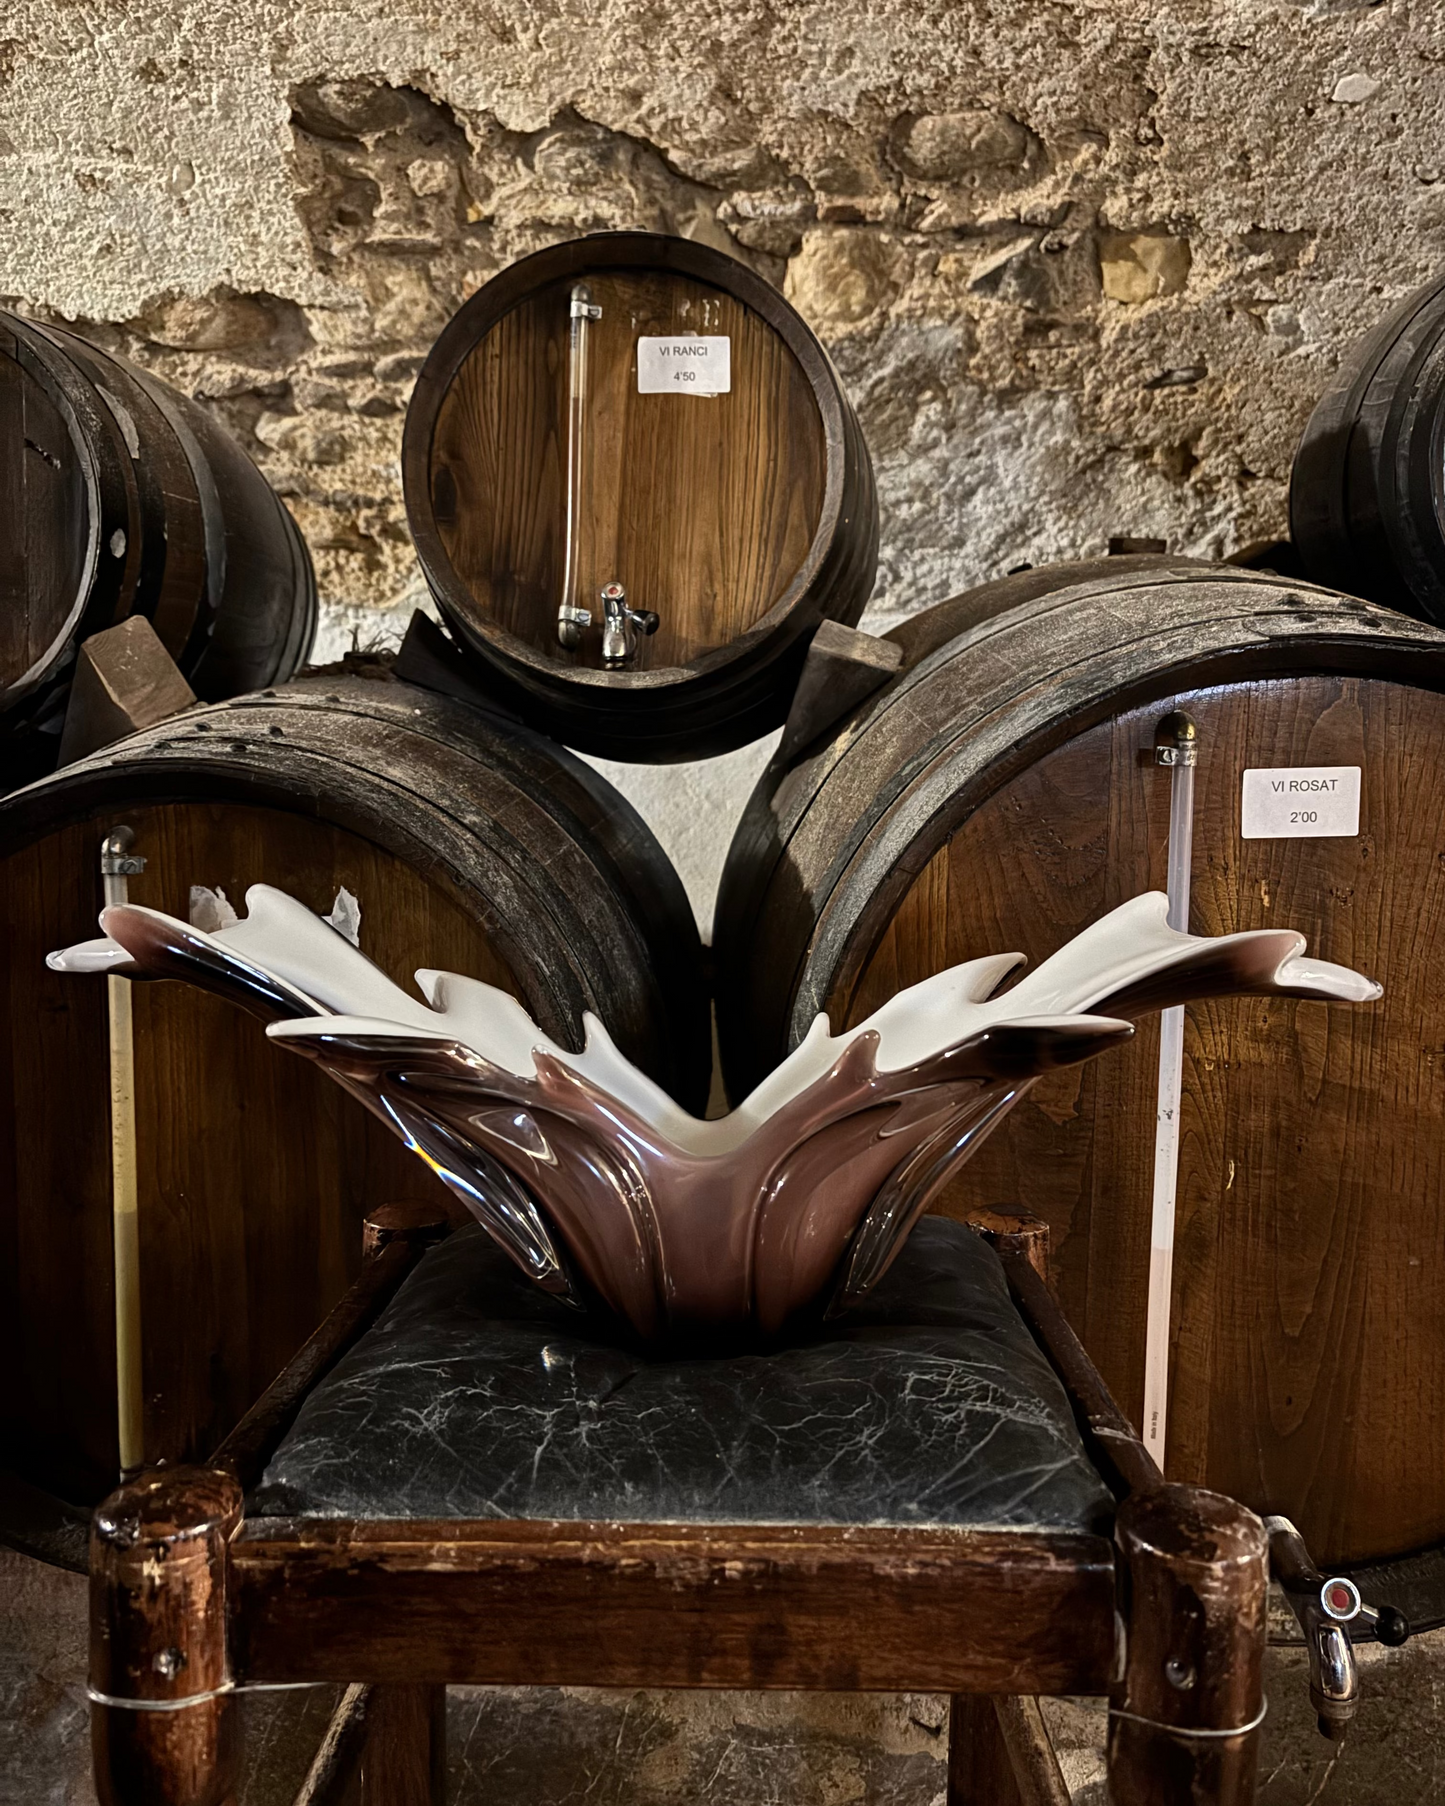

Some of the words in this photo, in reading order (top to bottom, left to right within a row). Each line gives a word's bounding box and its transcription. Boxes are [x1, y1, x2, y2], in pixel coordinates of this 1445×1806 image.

[659, 346, 670, 356] VI
[673, 346, 708, 356] RANCI
[673, 371, 696, 381] 4'50
[1271, 781, 1285, 792] VI
[1289, 779, 1338, 792] ROSAT
[1290, 811, 1318, 823] 2'00
